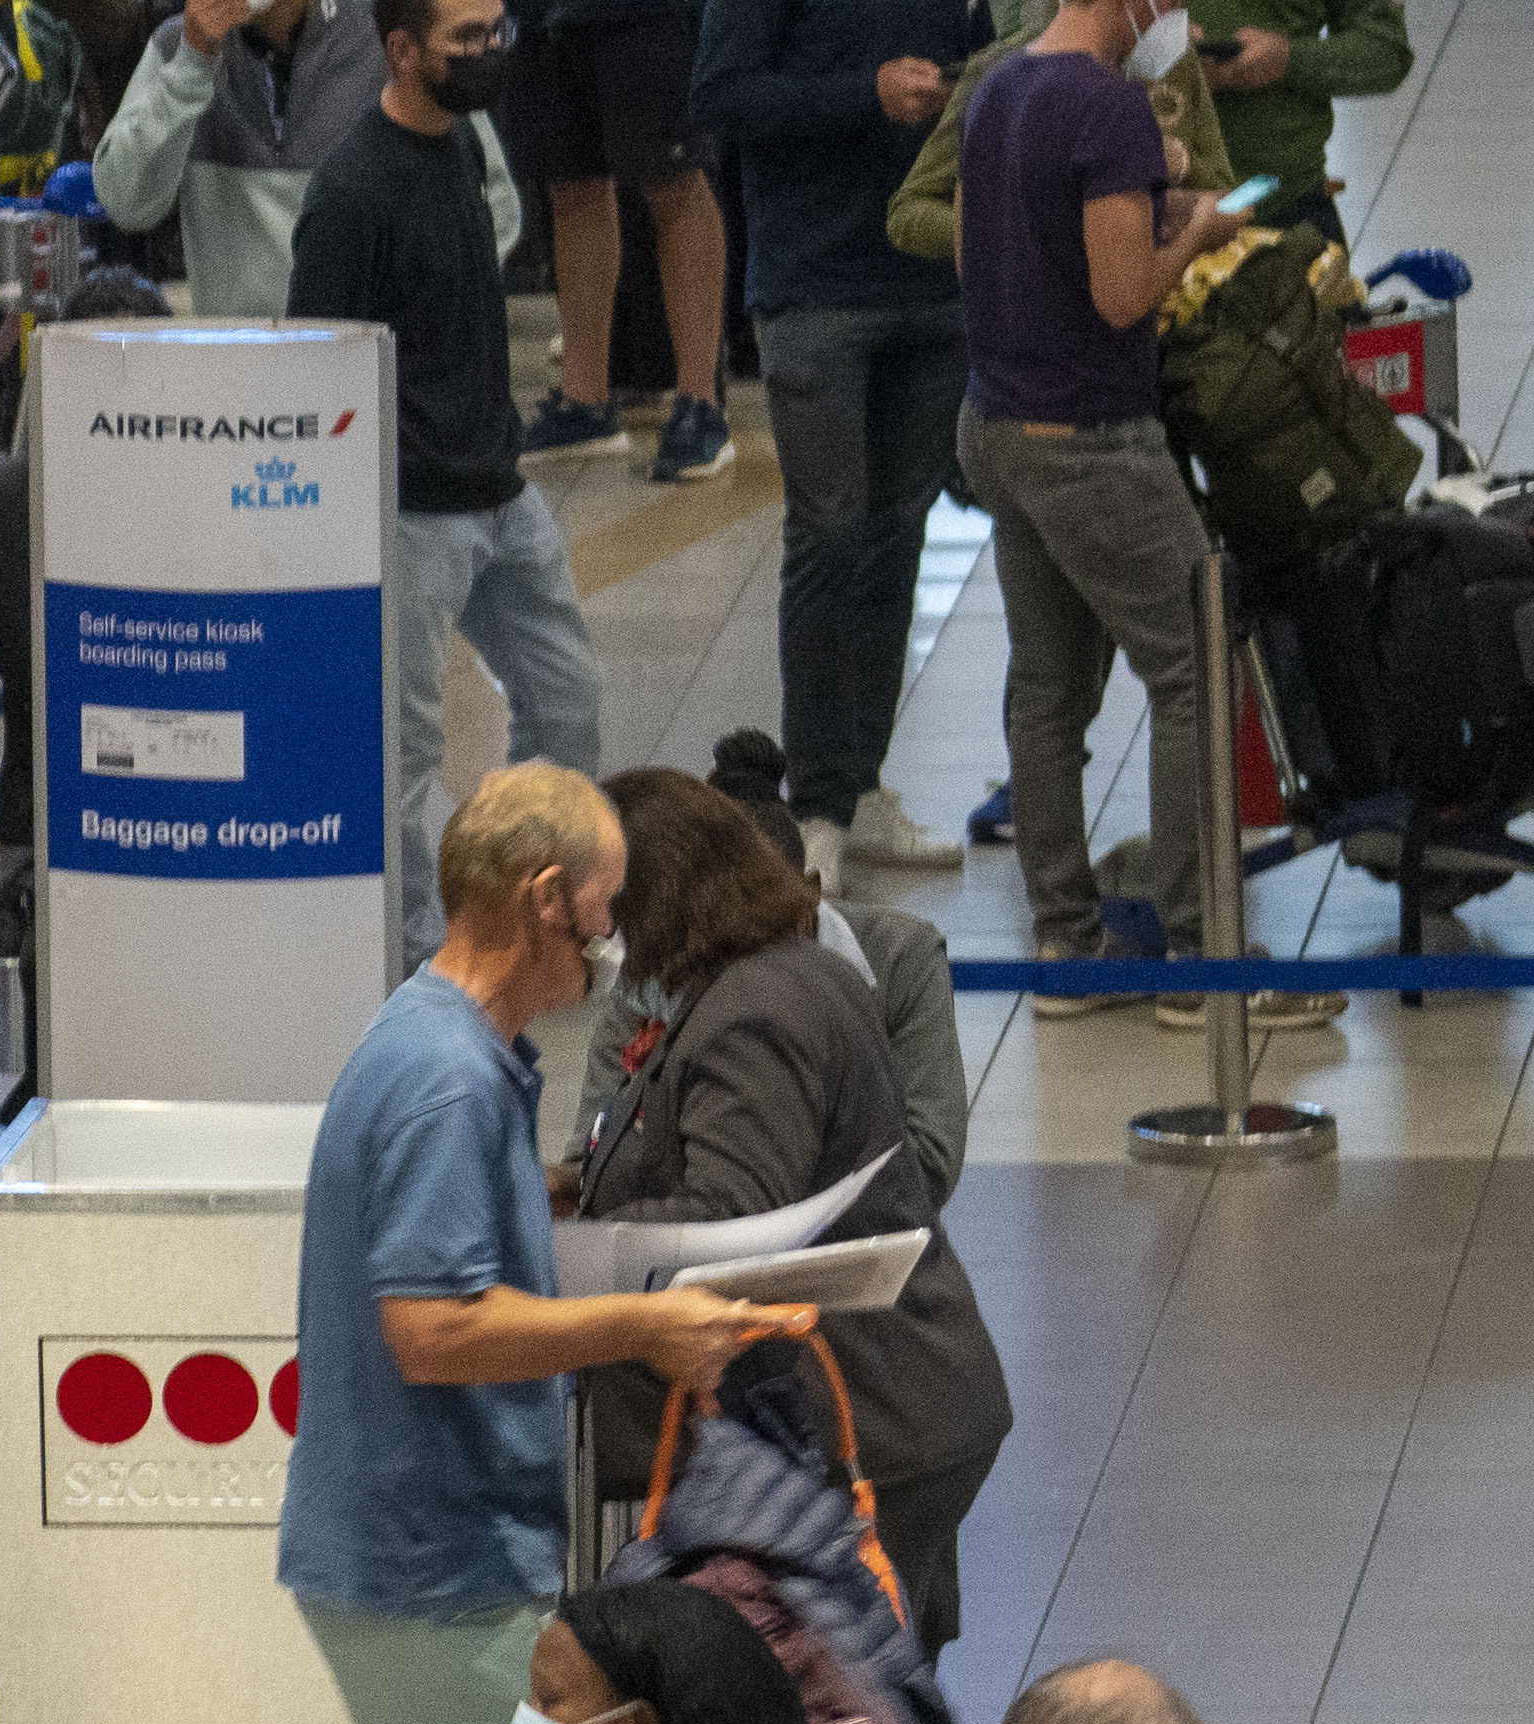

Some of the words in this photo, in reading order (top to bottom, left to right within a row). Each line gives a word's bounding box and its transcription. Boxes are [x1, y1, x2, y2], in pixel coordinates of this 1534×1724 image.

[89, 411, 320, 441] AIRFRANCE
[230, 483, 321, 509] KLM
[79, 610, 200, 643] Self-service
[205, 618, 264, 643] kiosk
[79, 640, 169, 674] boarding
[174, 650, 228, 674] pass
[82, 809, 209, 852] Baggage
[217, 814, 342, 851] drop-off
